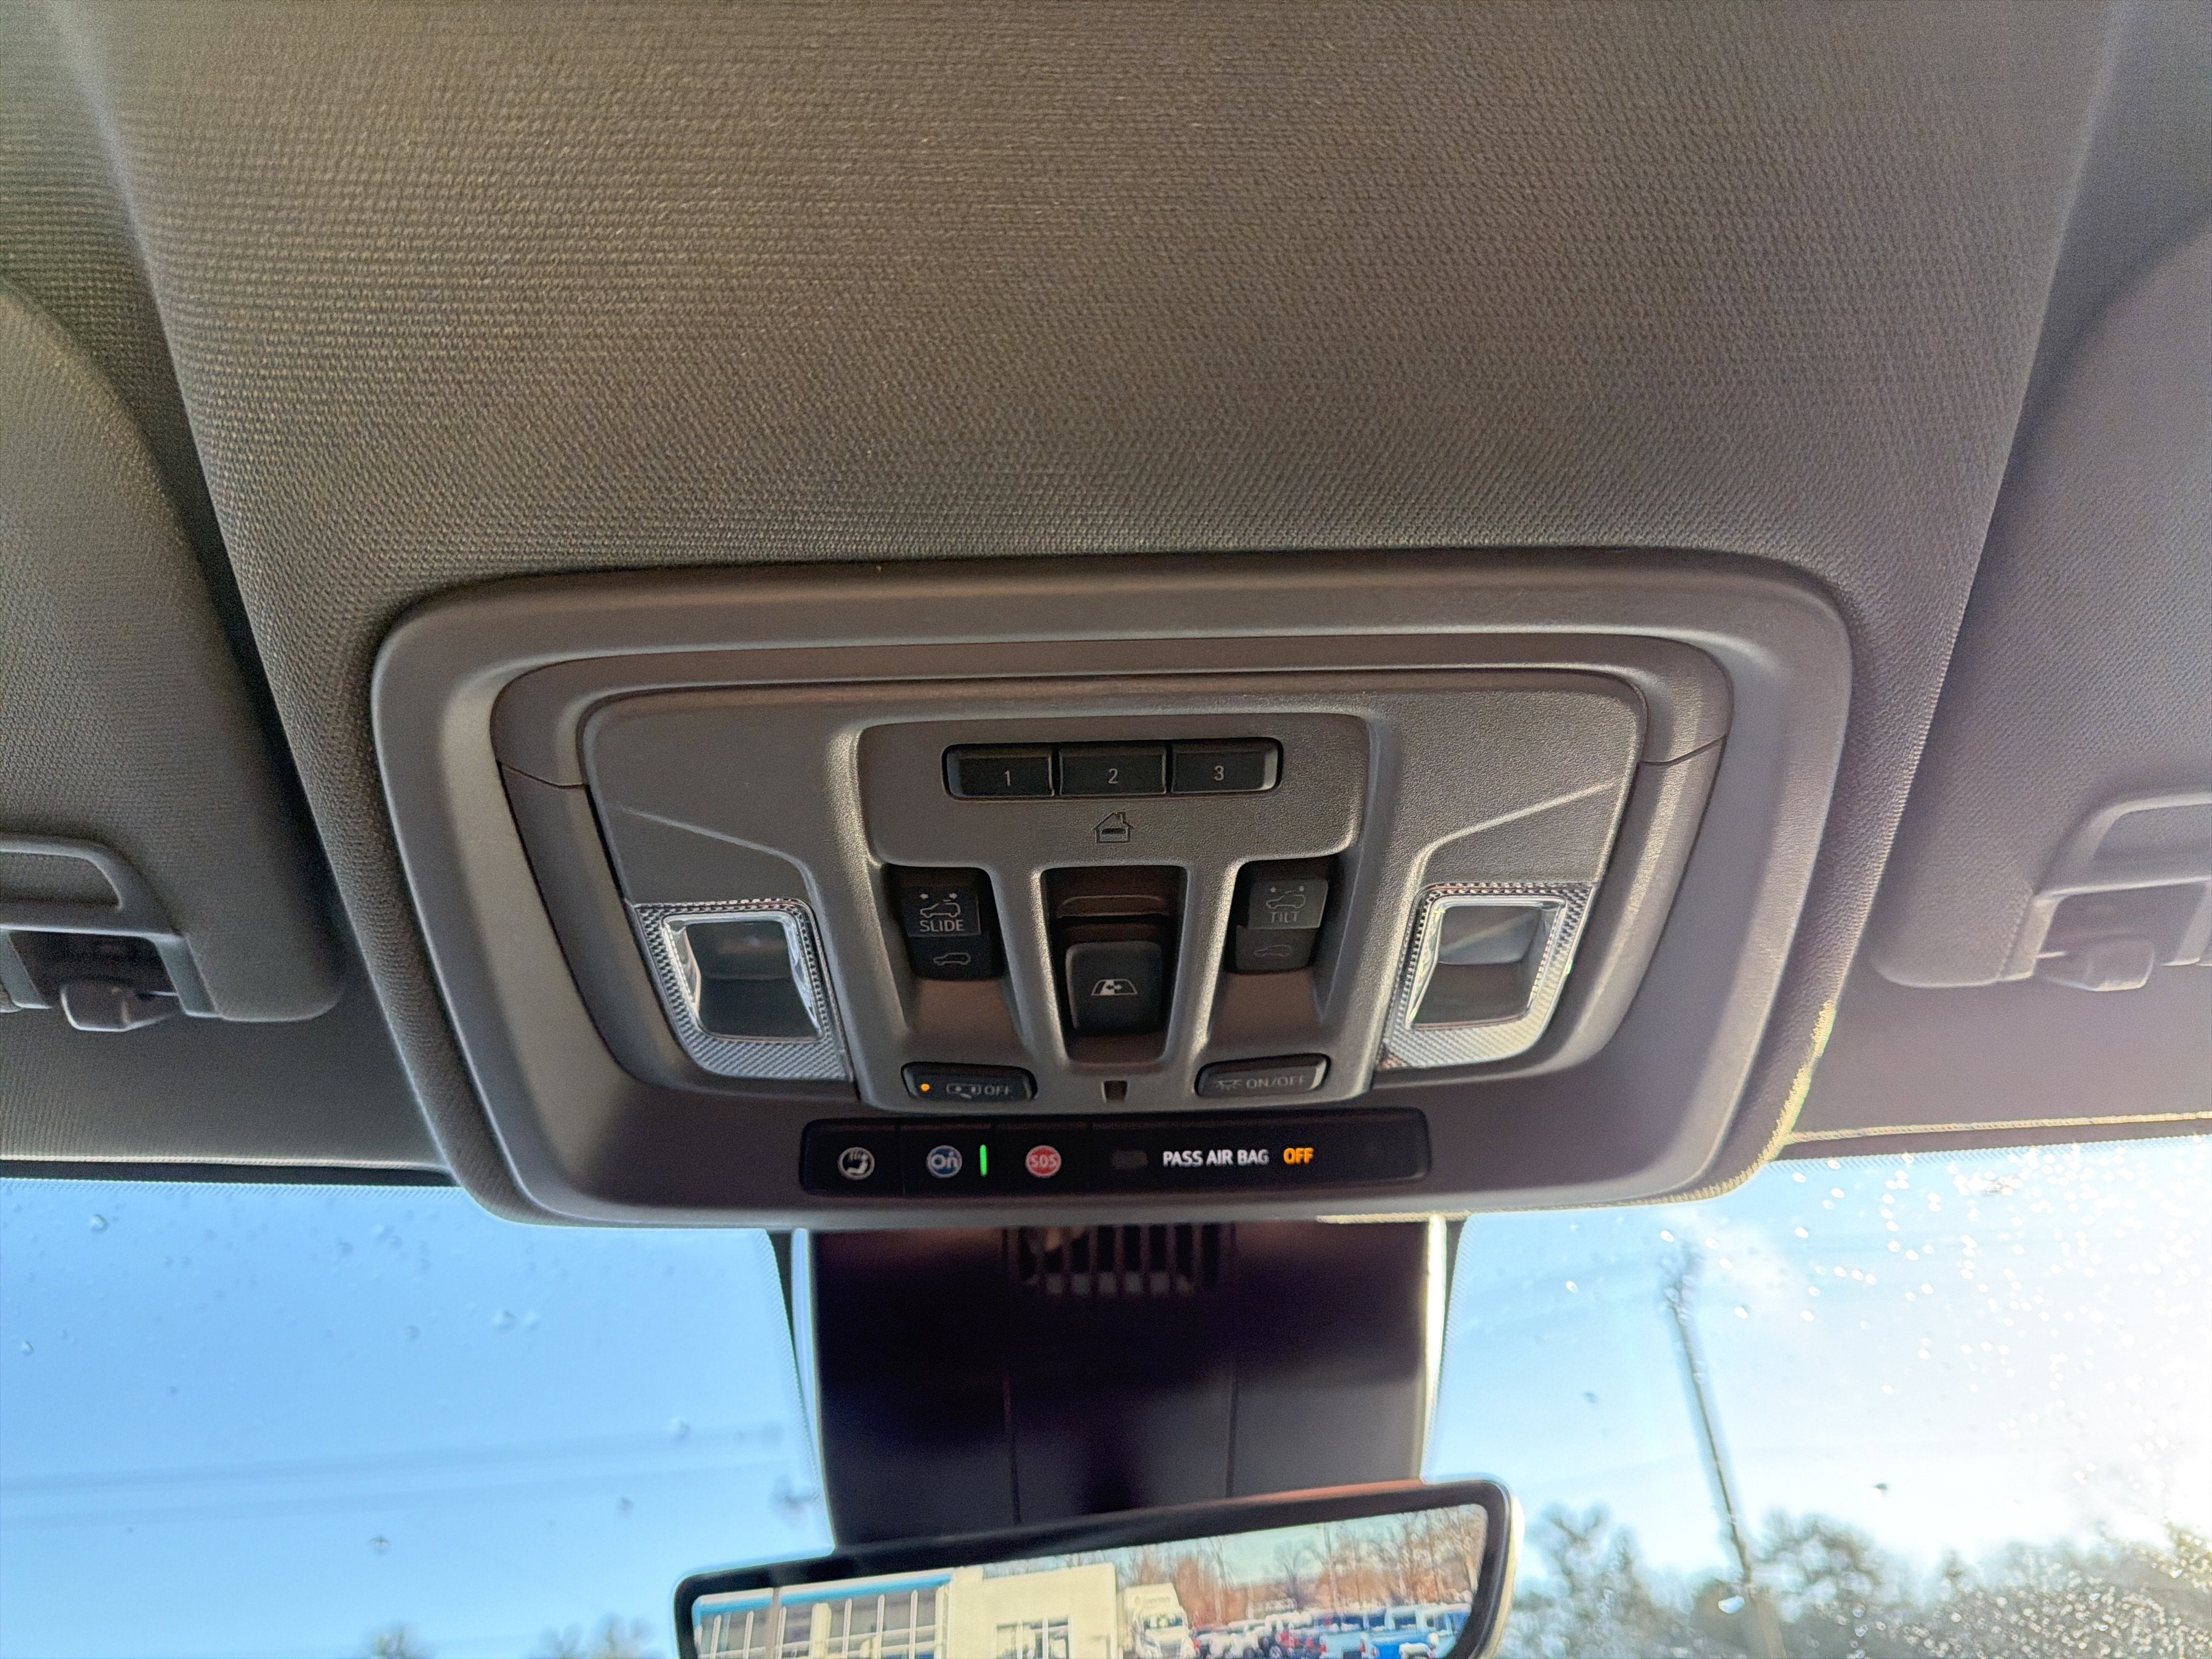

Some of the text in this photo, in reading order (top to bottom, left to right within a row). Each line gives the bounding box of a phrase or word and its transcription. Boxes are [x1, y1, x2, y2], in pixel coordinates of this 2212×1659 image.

[1004, 770, 1011, 786] 1
[1108, 769, 1118, 784] 2
[1214, 765, 1224, 781] 3
[1270, 911, 1300, 922] TILT
[919, 919, 964, 932] SLIDE
[1246, 1075, 1304, 1089] ON/OFF
[985, 1085, 1011, 1096] OFF
[1030, 1154, 1057, 1167] SOS
[1163, 1148, 1314, 1167] PASS AIR BAG OFF
